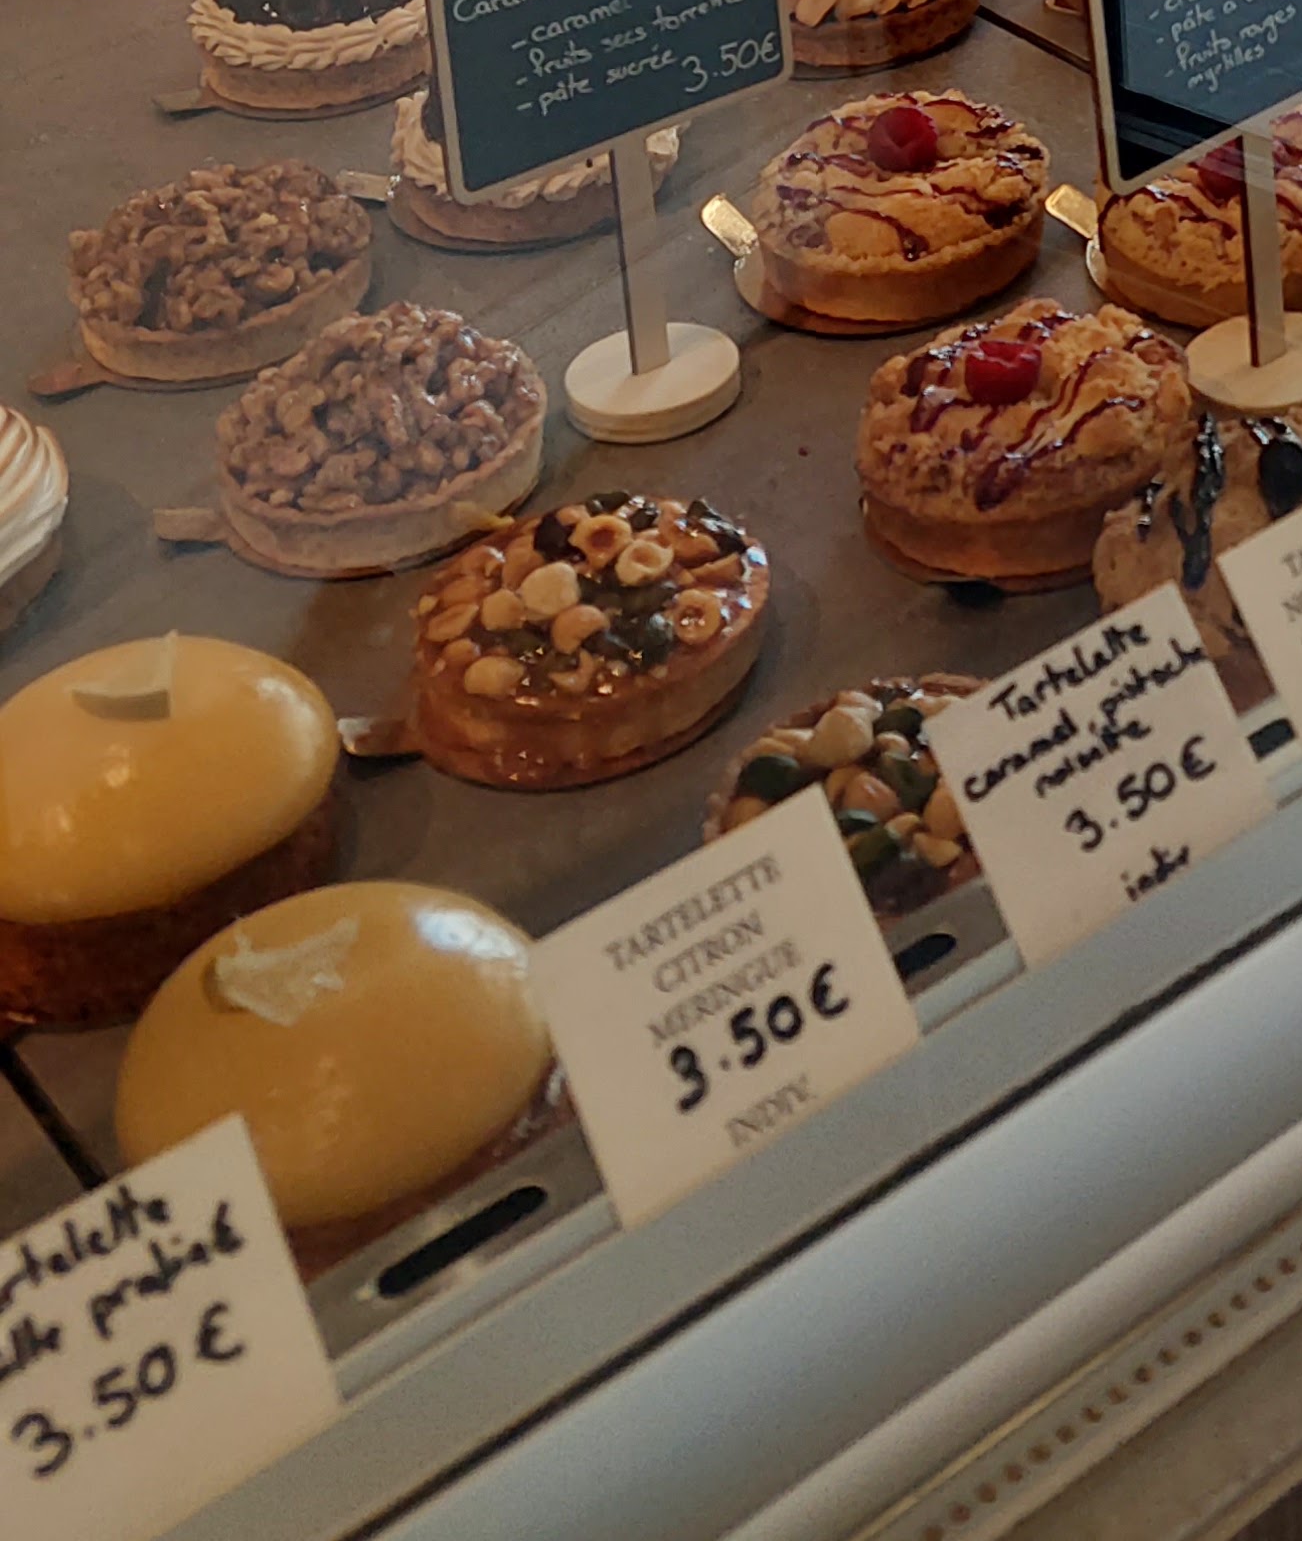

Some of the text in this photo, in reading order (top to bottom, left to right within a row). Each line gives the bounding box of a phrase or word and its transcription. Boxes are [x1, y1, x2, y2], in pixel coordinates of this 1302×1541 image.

[538, 77, 594, 117] pâte
[682, 30, 781, 93] 3.50€
[986, 623, 1150, 721] Tartelette
[606, 853, 784, 971] TARTELETTE
[653, 910, 766, 994] CITRON
